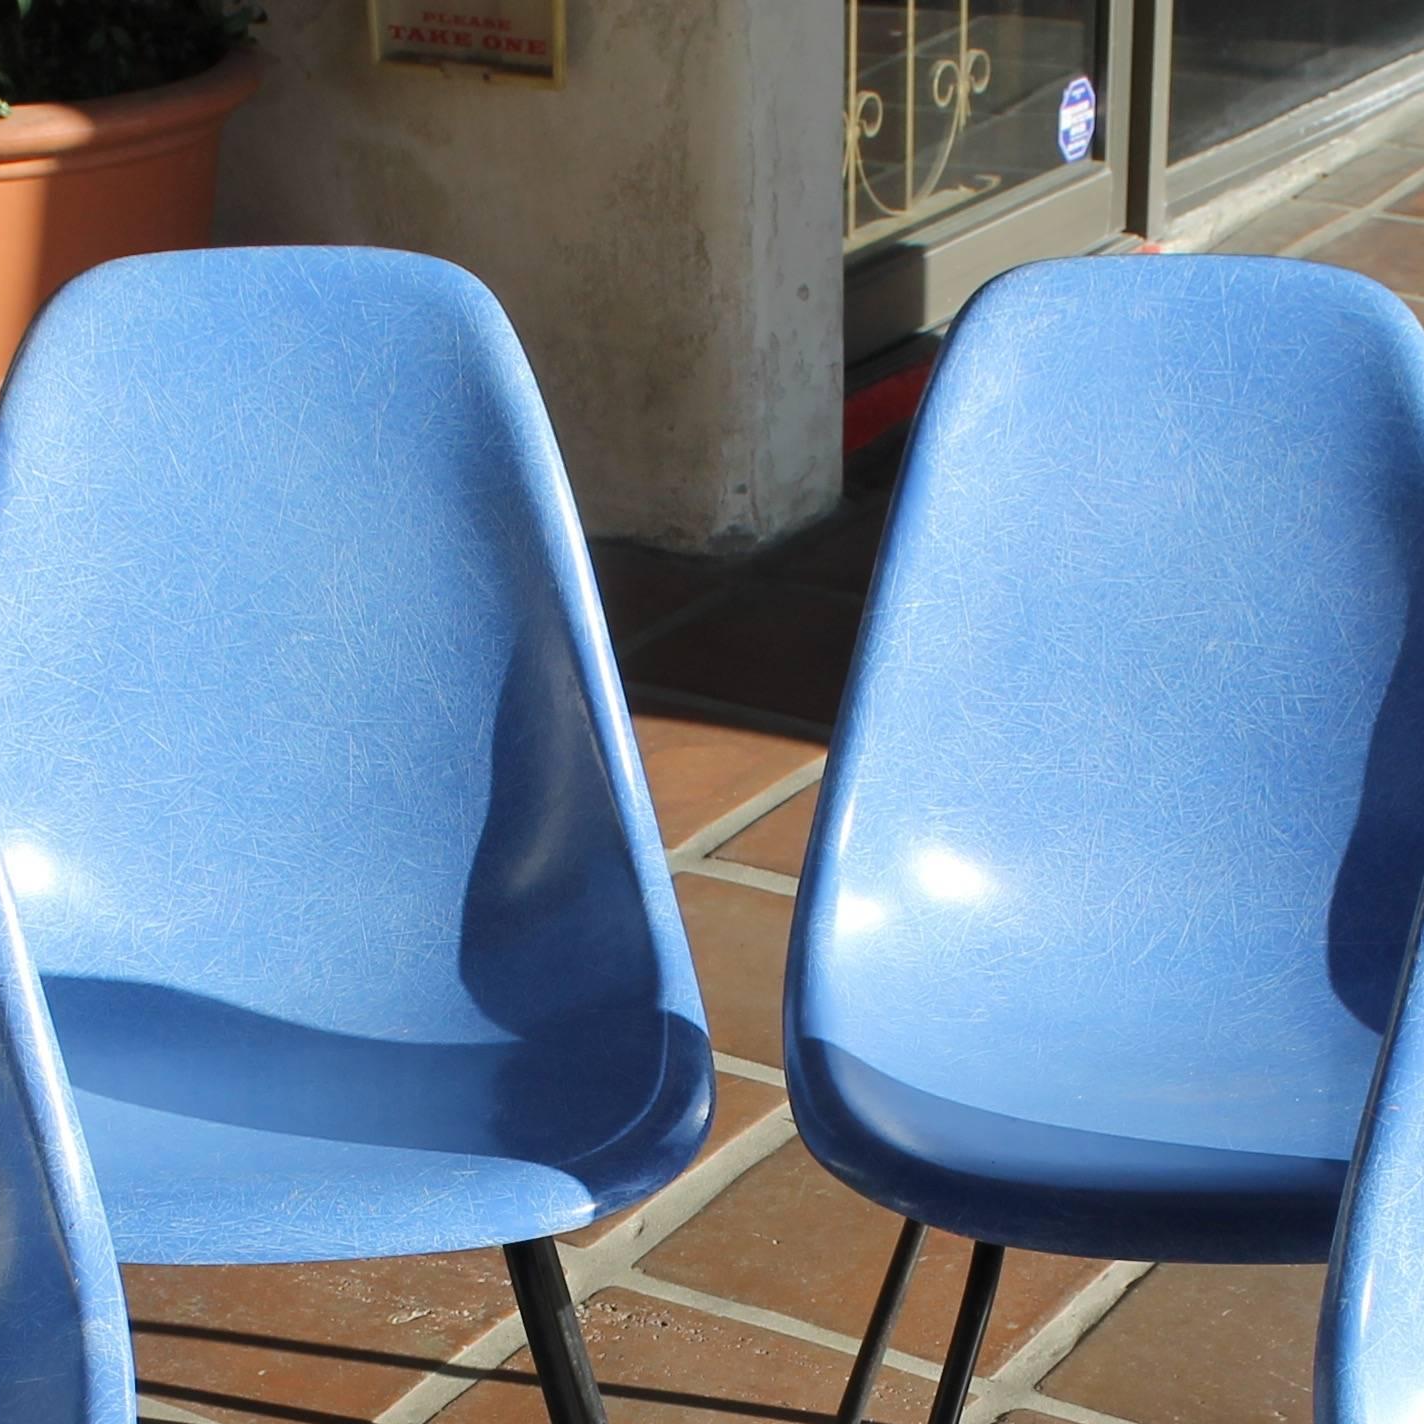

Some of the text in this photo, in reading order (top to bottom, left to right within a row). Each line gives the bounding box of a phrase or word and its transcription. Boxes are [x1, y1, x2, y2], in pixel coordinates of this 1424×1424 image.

[423, 12, 511, 31] PLEASE
[389, 25, 546, 55] TAKE ONE
